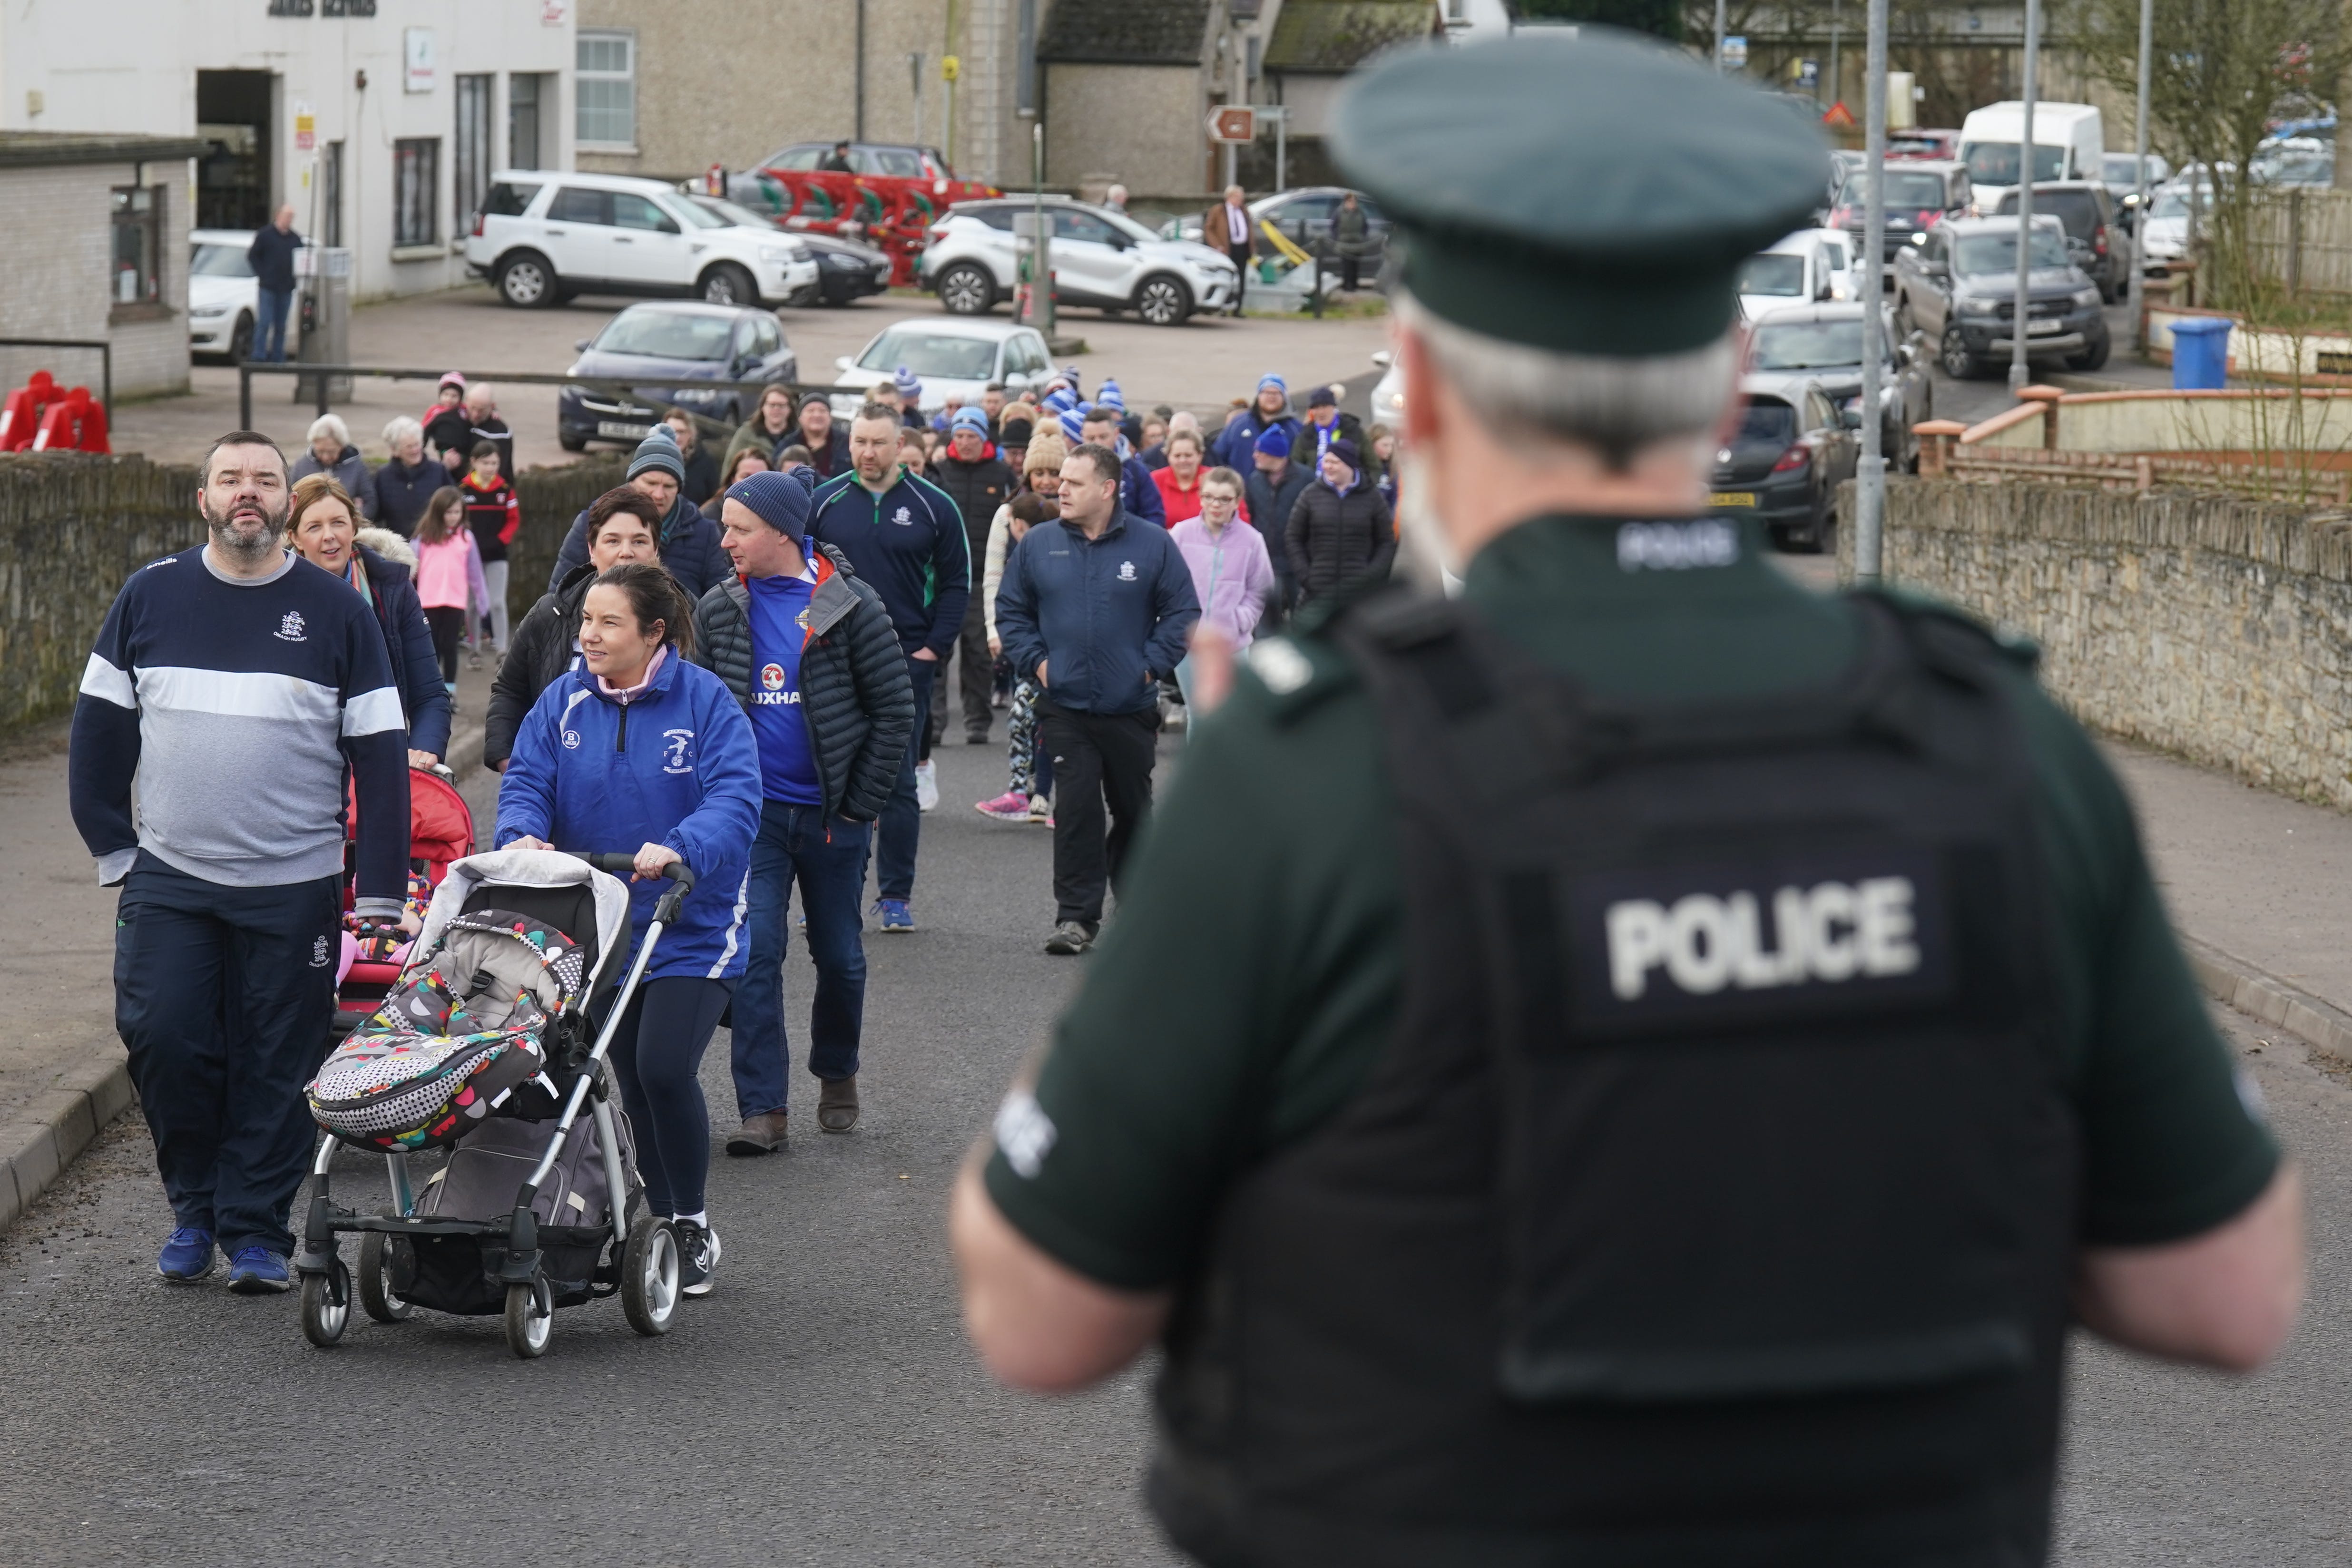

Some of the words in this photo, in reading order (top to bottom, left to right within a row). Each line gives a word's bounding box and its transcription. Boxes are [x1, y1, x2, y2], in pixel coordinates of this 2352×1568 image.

[1617, 519, 1740, 573] POLICE
[273, 631, 291, 641] OMAGH
[1605, 877, 1922, 999] POLICE
